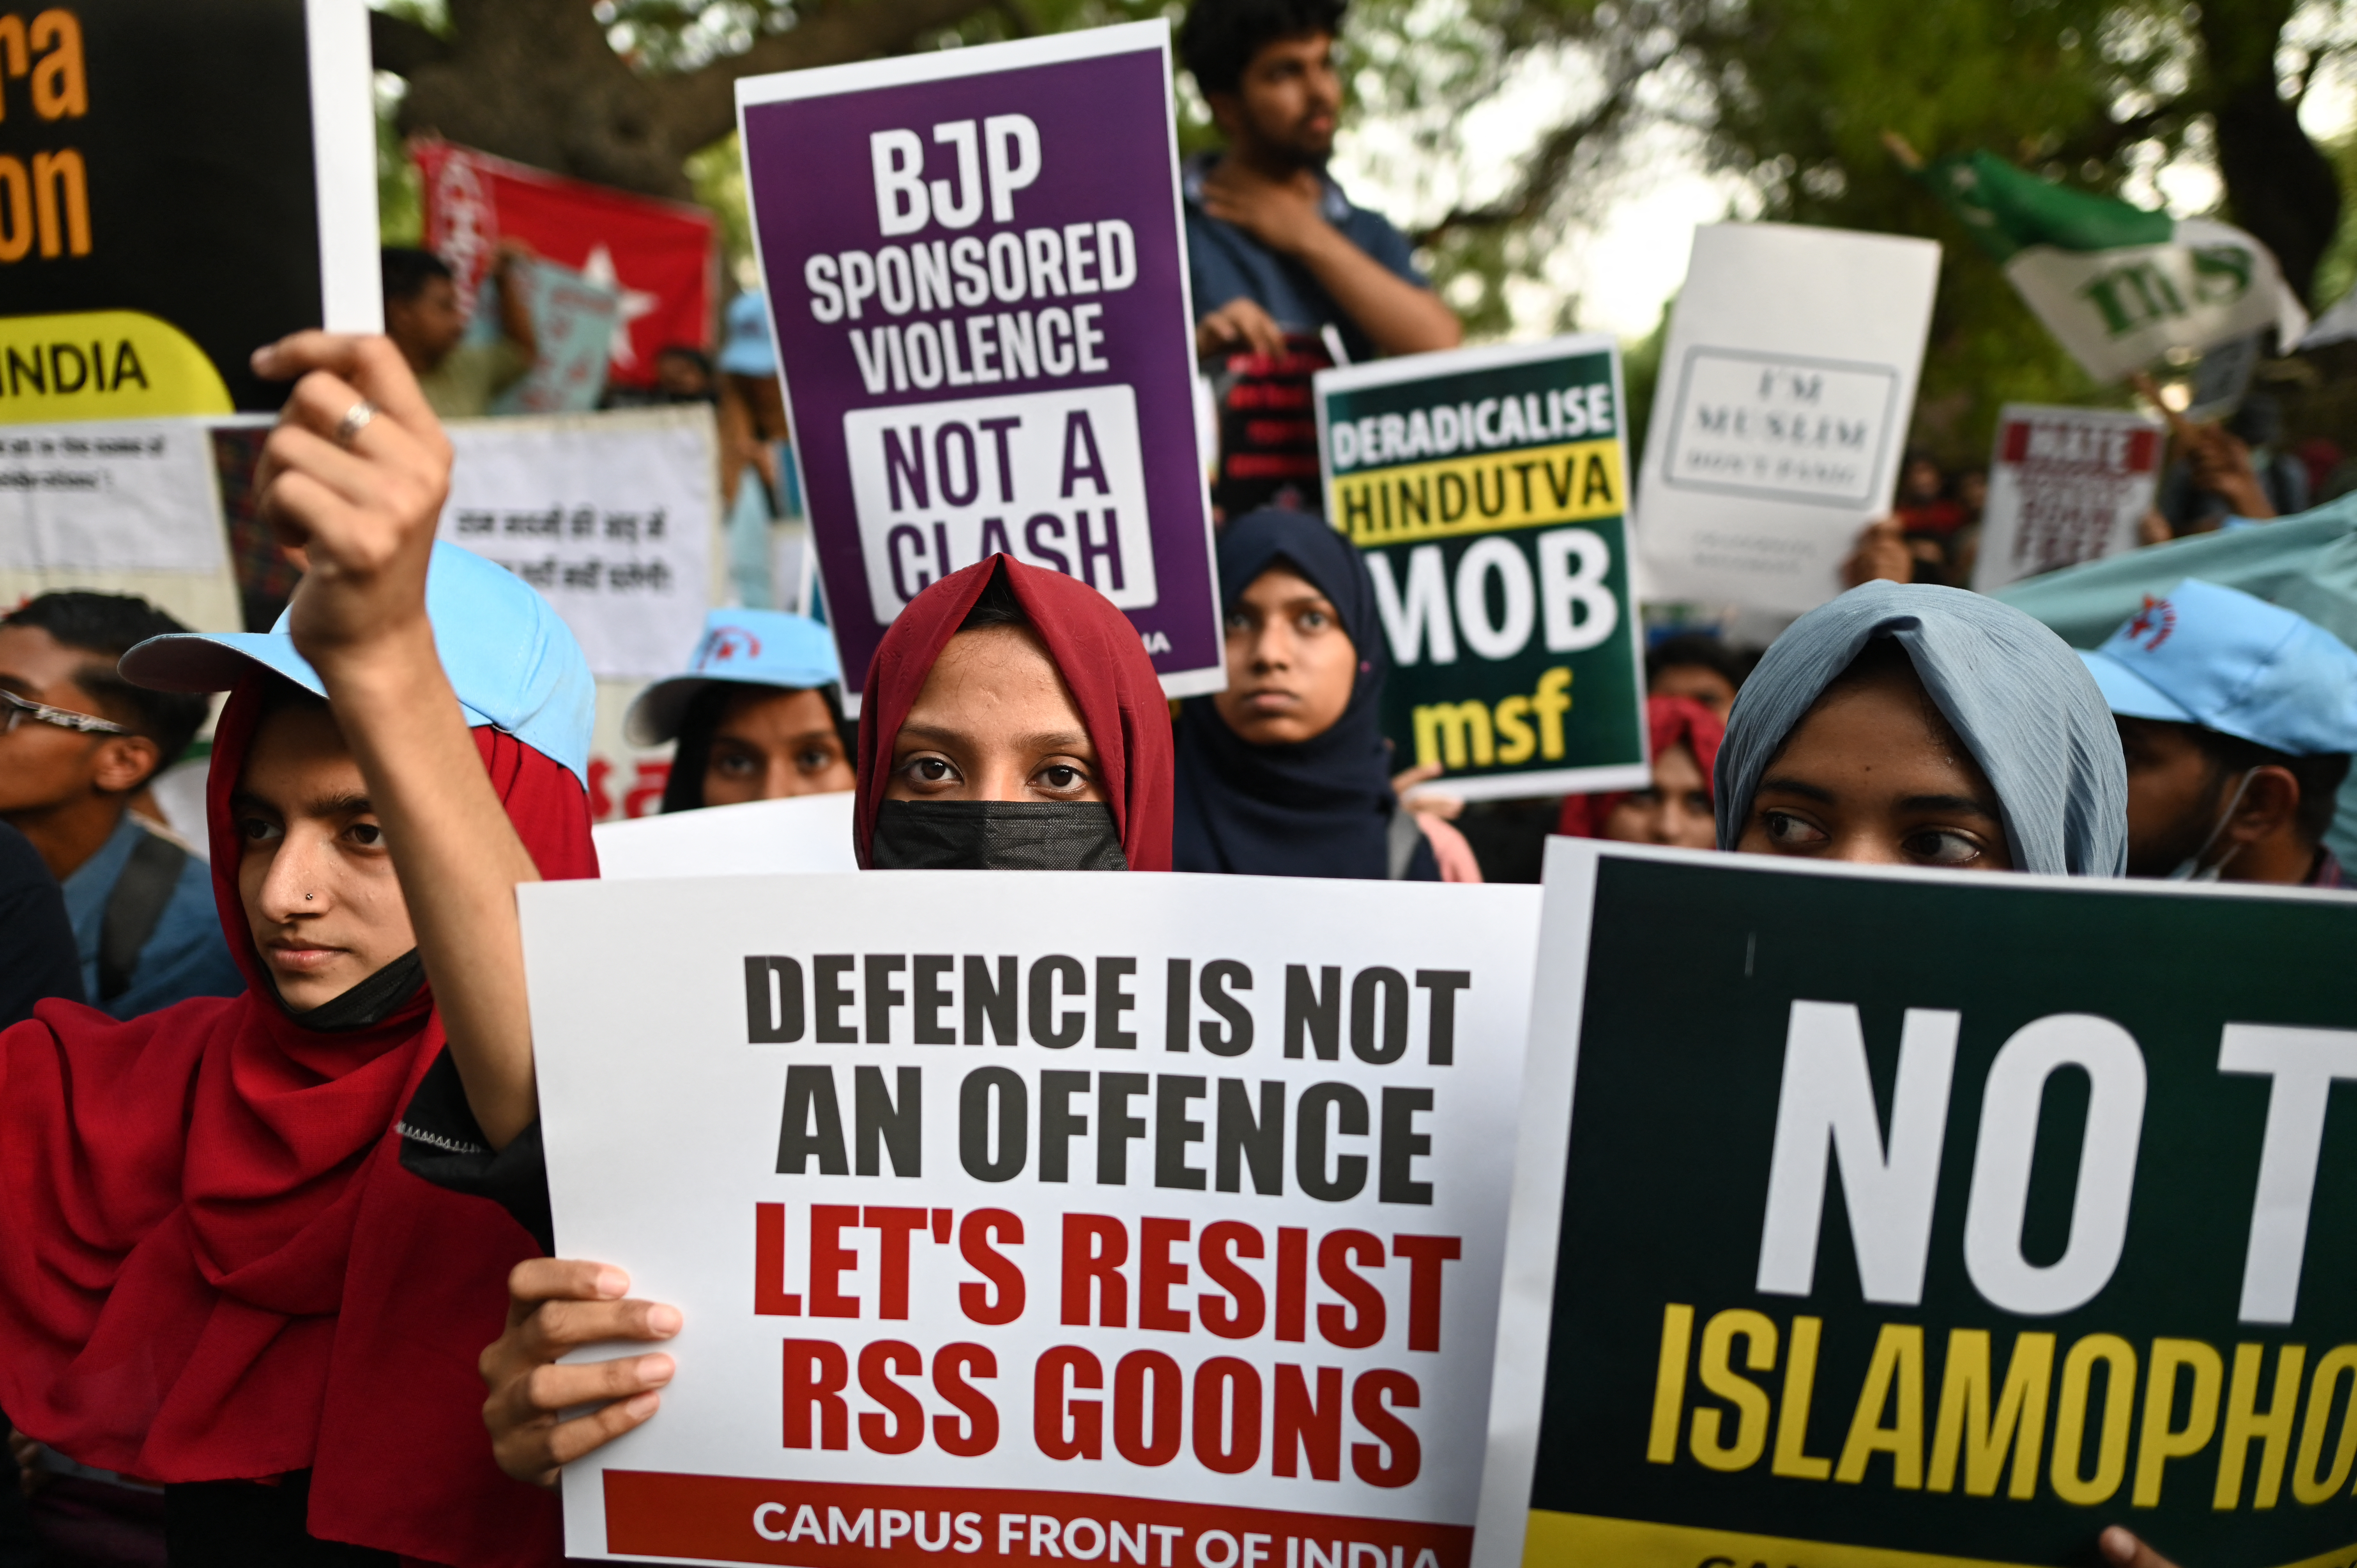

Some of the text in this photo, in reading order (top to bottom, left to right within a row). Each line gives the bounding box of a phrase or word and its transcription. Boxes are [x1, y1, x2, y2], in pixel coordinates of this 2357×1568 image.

[870, 113, 1041, 236] BJP
[804, 219, 1137, 323] SPONSORED
[0, 339, 150, 397] NDIA
[849, 303, 1108, 394] VIOLENCE
[882, 410, 1110, 512] NOT A
[1330, 383, 1613, 469] DERADICALISE
[1342, 454, 1614, 533] HINDUTVA
[1364, 528, 1618, 666] MOB
[1412, 667, 1572, 769] msf
[744, 955, 1470, 1066] DEFENCE IS NOT
[775, 1065, 1433, 1205] AN OFFENCE
[1756, 1000, 2147, 1315] NO
[754, 1202, 1461, 1352] LET'S RESIST
[783, 1338, 1421, 1489] RSS GOONS
[1647, 1303, 2357, 1510] ISLAMOPHO
[753, 1502, 983, 1554] CAMPUS
[998, 1513, 1184, 1568] FRONT
[1195, 1529, 1272, 1568] OF
